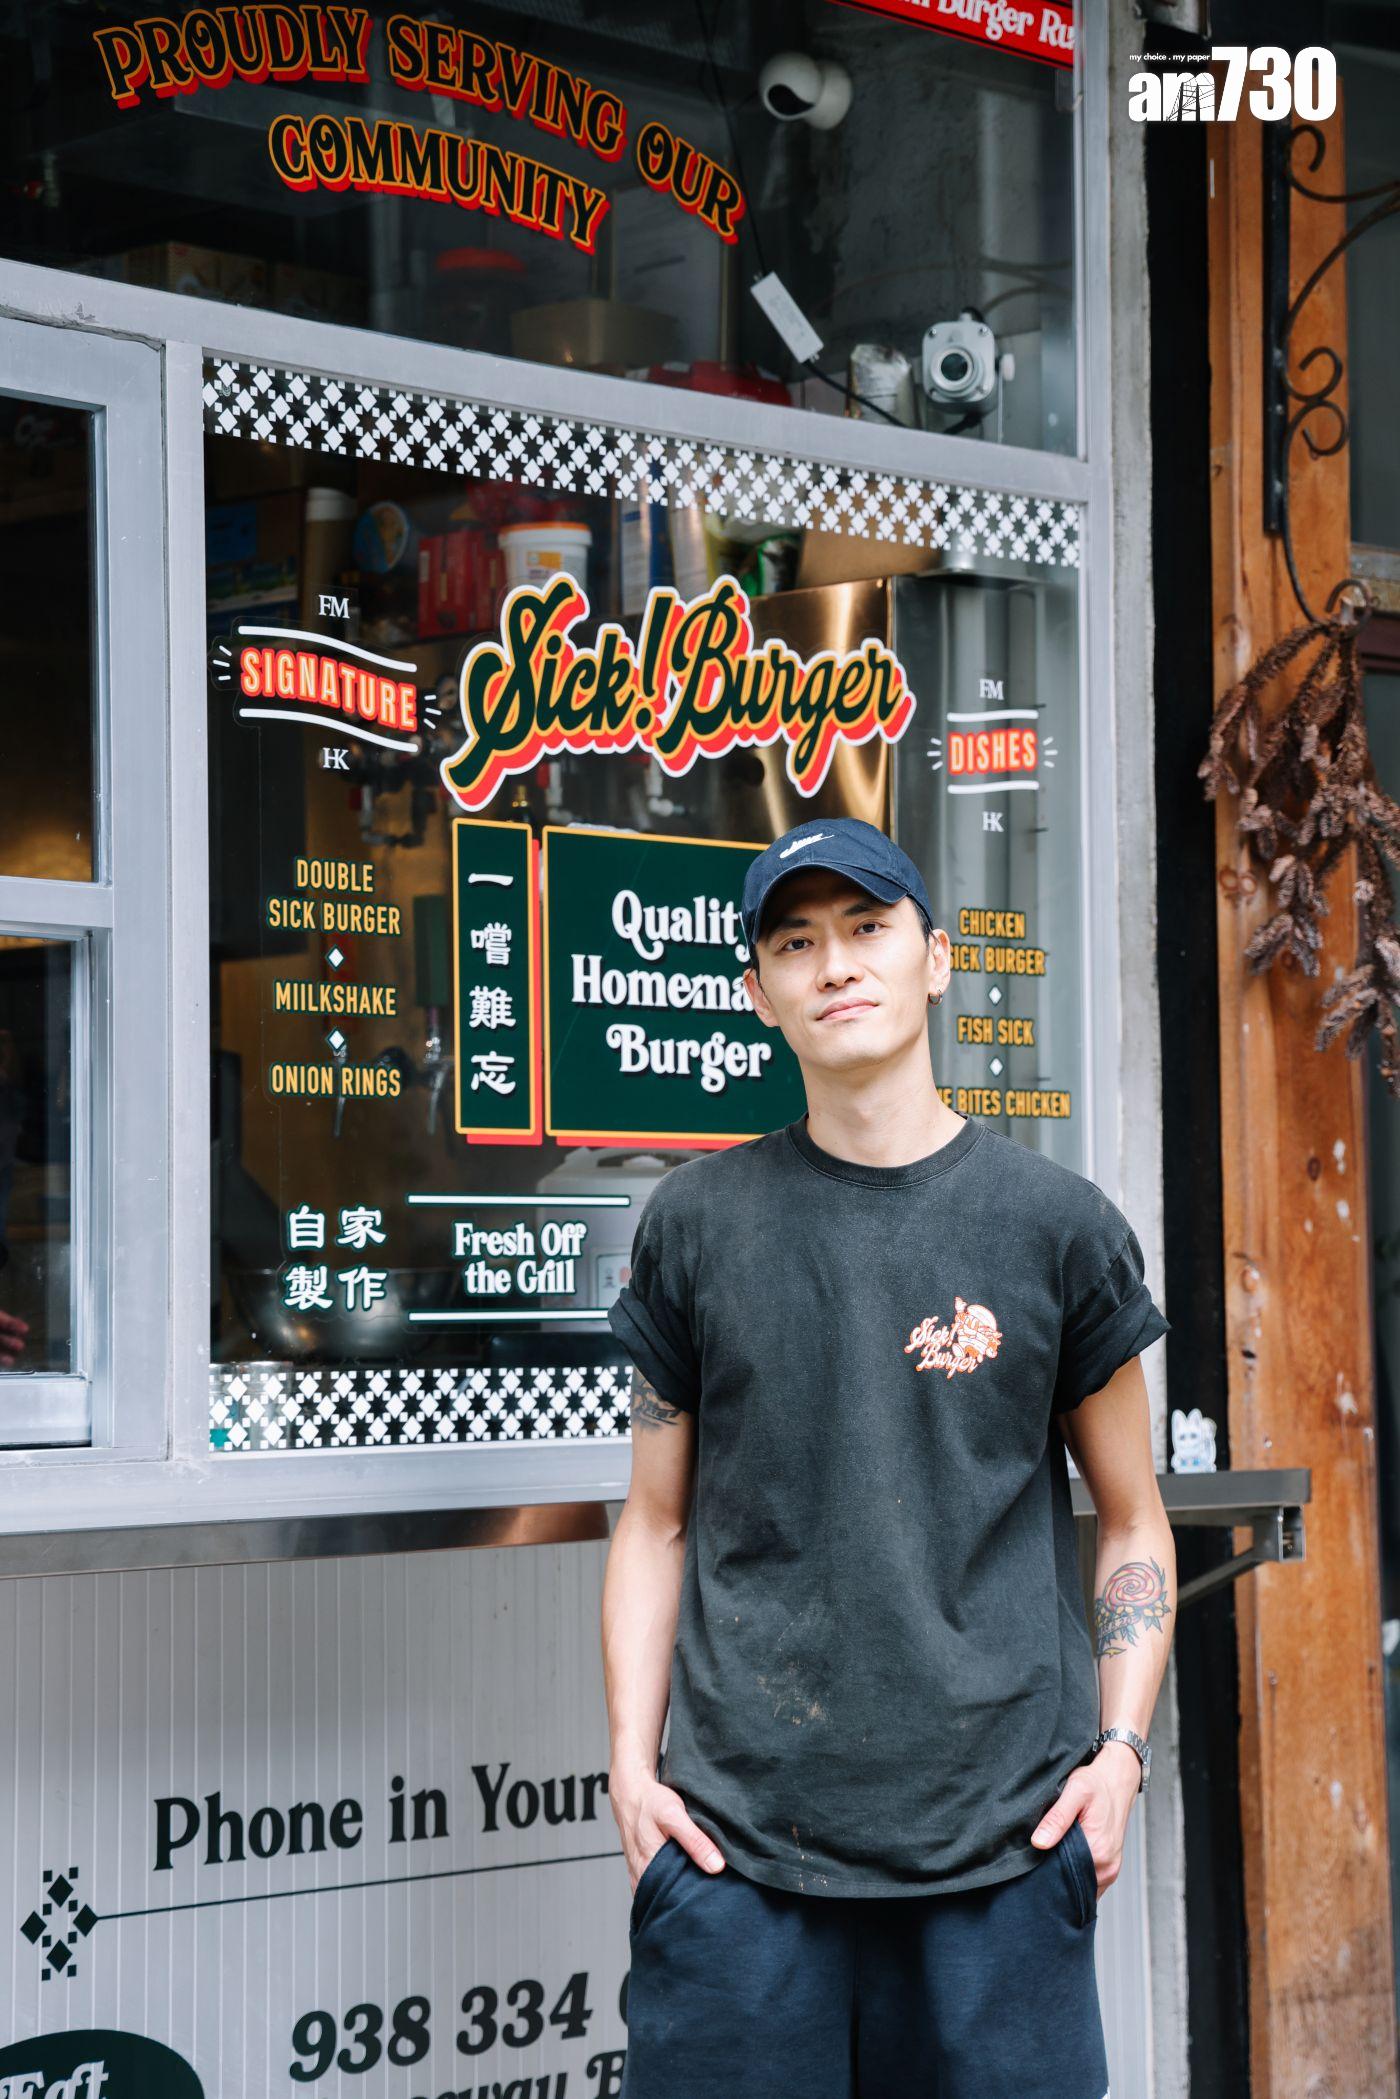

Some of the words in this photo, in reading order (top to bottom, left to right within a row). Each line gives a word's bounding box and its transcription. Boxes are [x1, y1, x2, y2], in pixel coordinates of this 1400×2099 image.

[94, 4, 373, 109] PROUDLY
[386, 14, 627, 162] SERVING
[636, 121, 746, 244] OUR
[268, 113, 609, 254] COMMUNITY
[318, 594, 350, 619] FM
[240, 647, 418, 732] SIGNATURE
[440, 572, 683, 812] Sick!
[653, 574, 916, 798] Burger
[979, 678, 1005, 701] FM
[322, 747, 350, 771] HK
[948, 728, 1037, 775] DISHES
[982, 811, 1005, 833] HK
[296, 859, 374, 892] DOUBLE
[268, 898, 316, 929] SICK
[322, 901, 401, 935] BURGER
[959, 908, 1026, 939] CHICKEN
[984, 946, 1046, 976] BURGER
[467, 872, 517, 1095] 一嚐難忘
[571, 953, 755, 1012] Homema
[957, 1016, 994, 1043] FISH
[997, 1018, 1035, 1045] SICK
[606, 1023, 772, 1094] Burger
[271, 1064, 334, 1095] ONION
[341, 1067, 401, 1097] RINGS
[957, 1087, 1001, 1116] BITES
[1005, 1090, 1071, 1118] CHICKEN
[289, 1205, 387, 1249] 自家
[454, 1222, 536, 1256] Fresh
[541, 1222, 588, 1256] Off
[284, 1265, 388, 1310] 製作
[464, 1260, 511, 1294] the
[516, 1259, 576, 1294] Grill
[153, 1790, 363, 1871] Phone
[388, 1775, 450, 1843] in
[471, 1762, 610, 1834] Your
[289, 1995, 431, 2083] 938
[456, 1971, 594, 2056] 334
